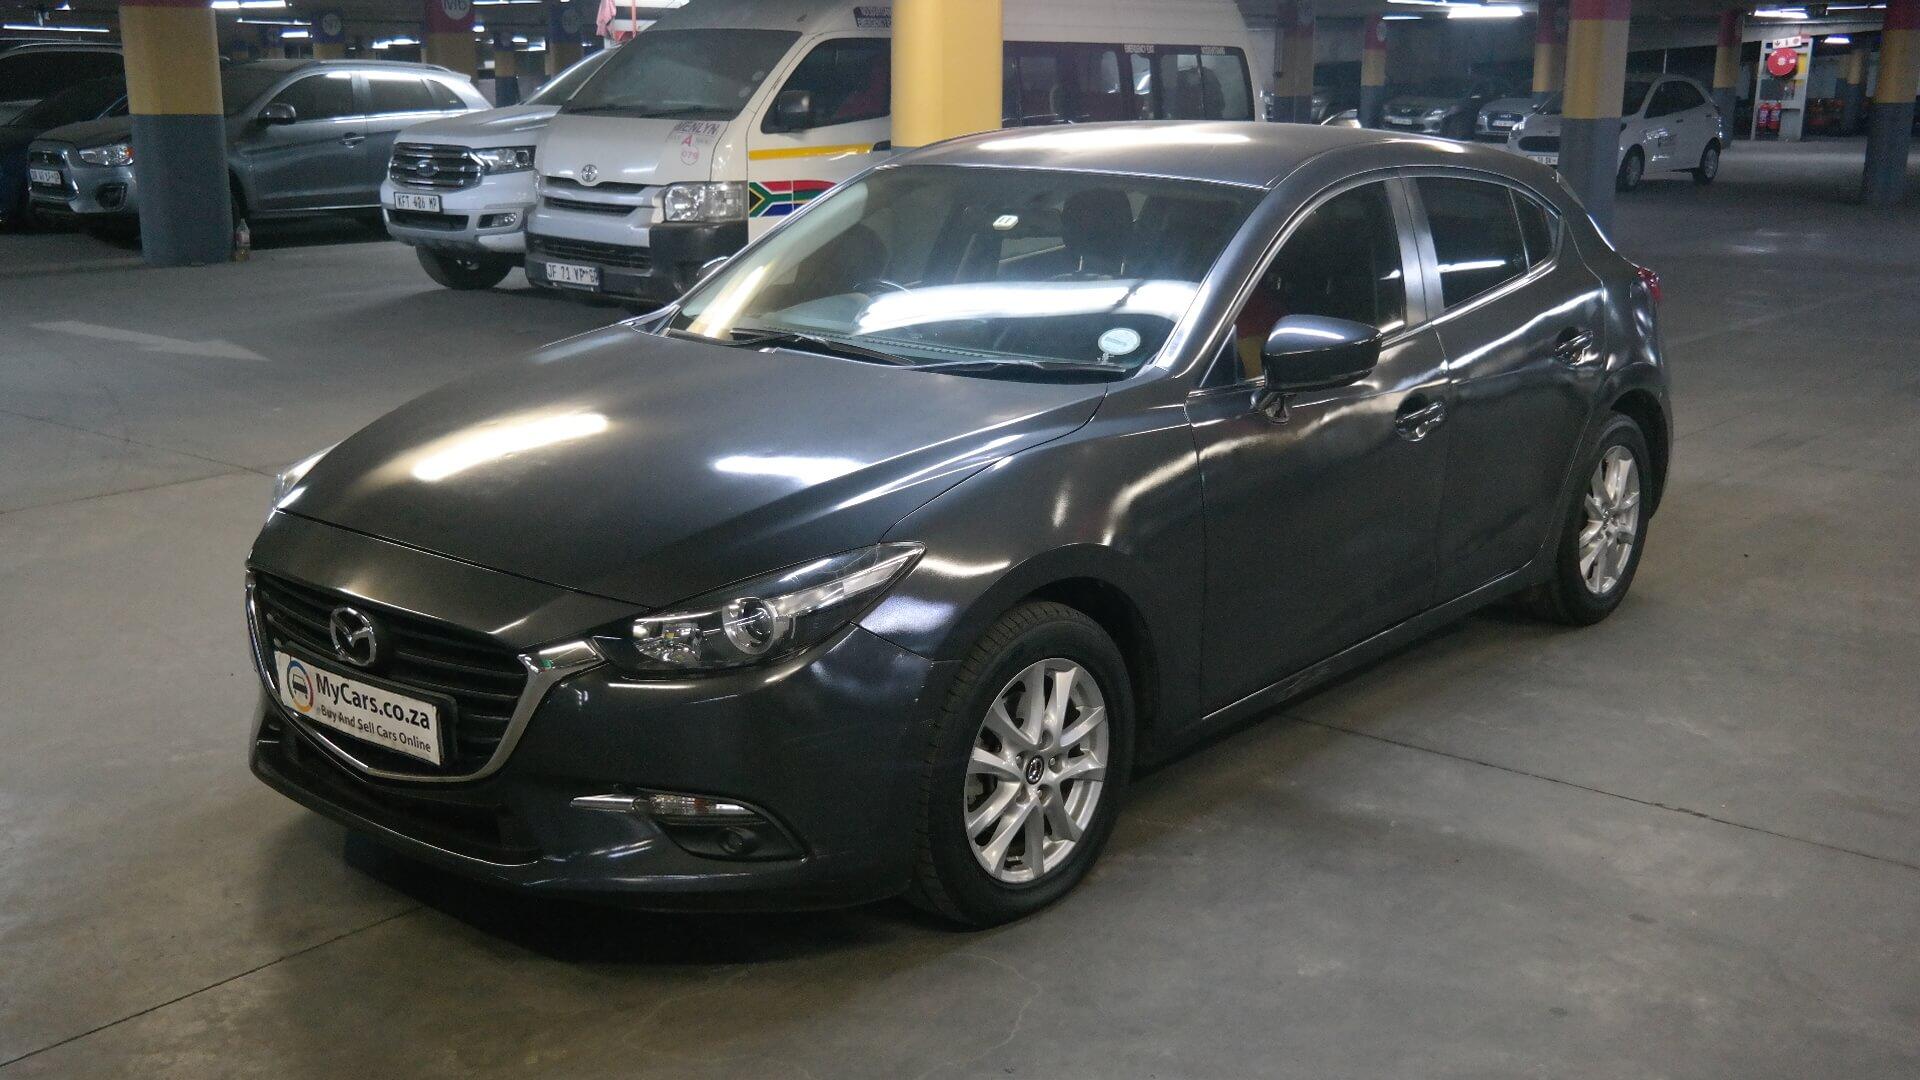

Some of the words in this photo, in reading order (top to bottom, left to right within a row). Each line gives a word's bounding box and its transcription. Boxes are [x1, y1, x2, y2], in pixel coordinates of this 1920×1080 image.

[315, 673, 431, 730] MyCars.co.za
[320, 705, 337, 723] Buy
[338, 712, 356, 728] And
[357, 718, 375, 734] Sell
[376, 725, 397, 742] Cars
[398, 733, 431, 753] Online
